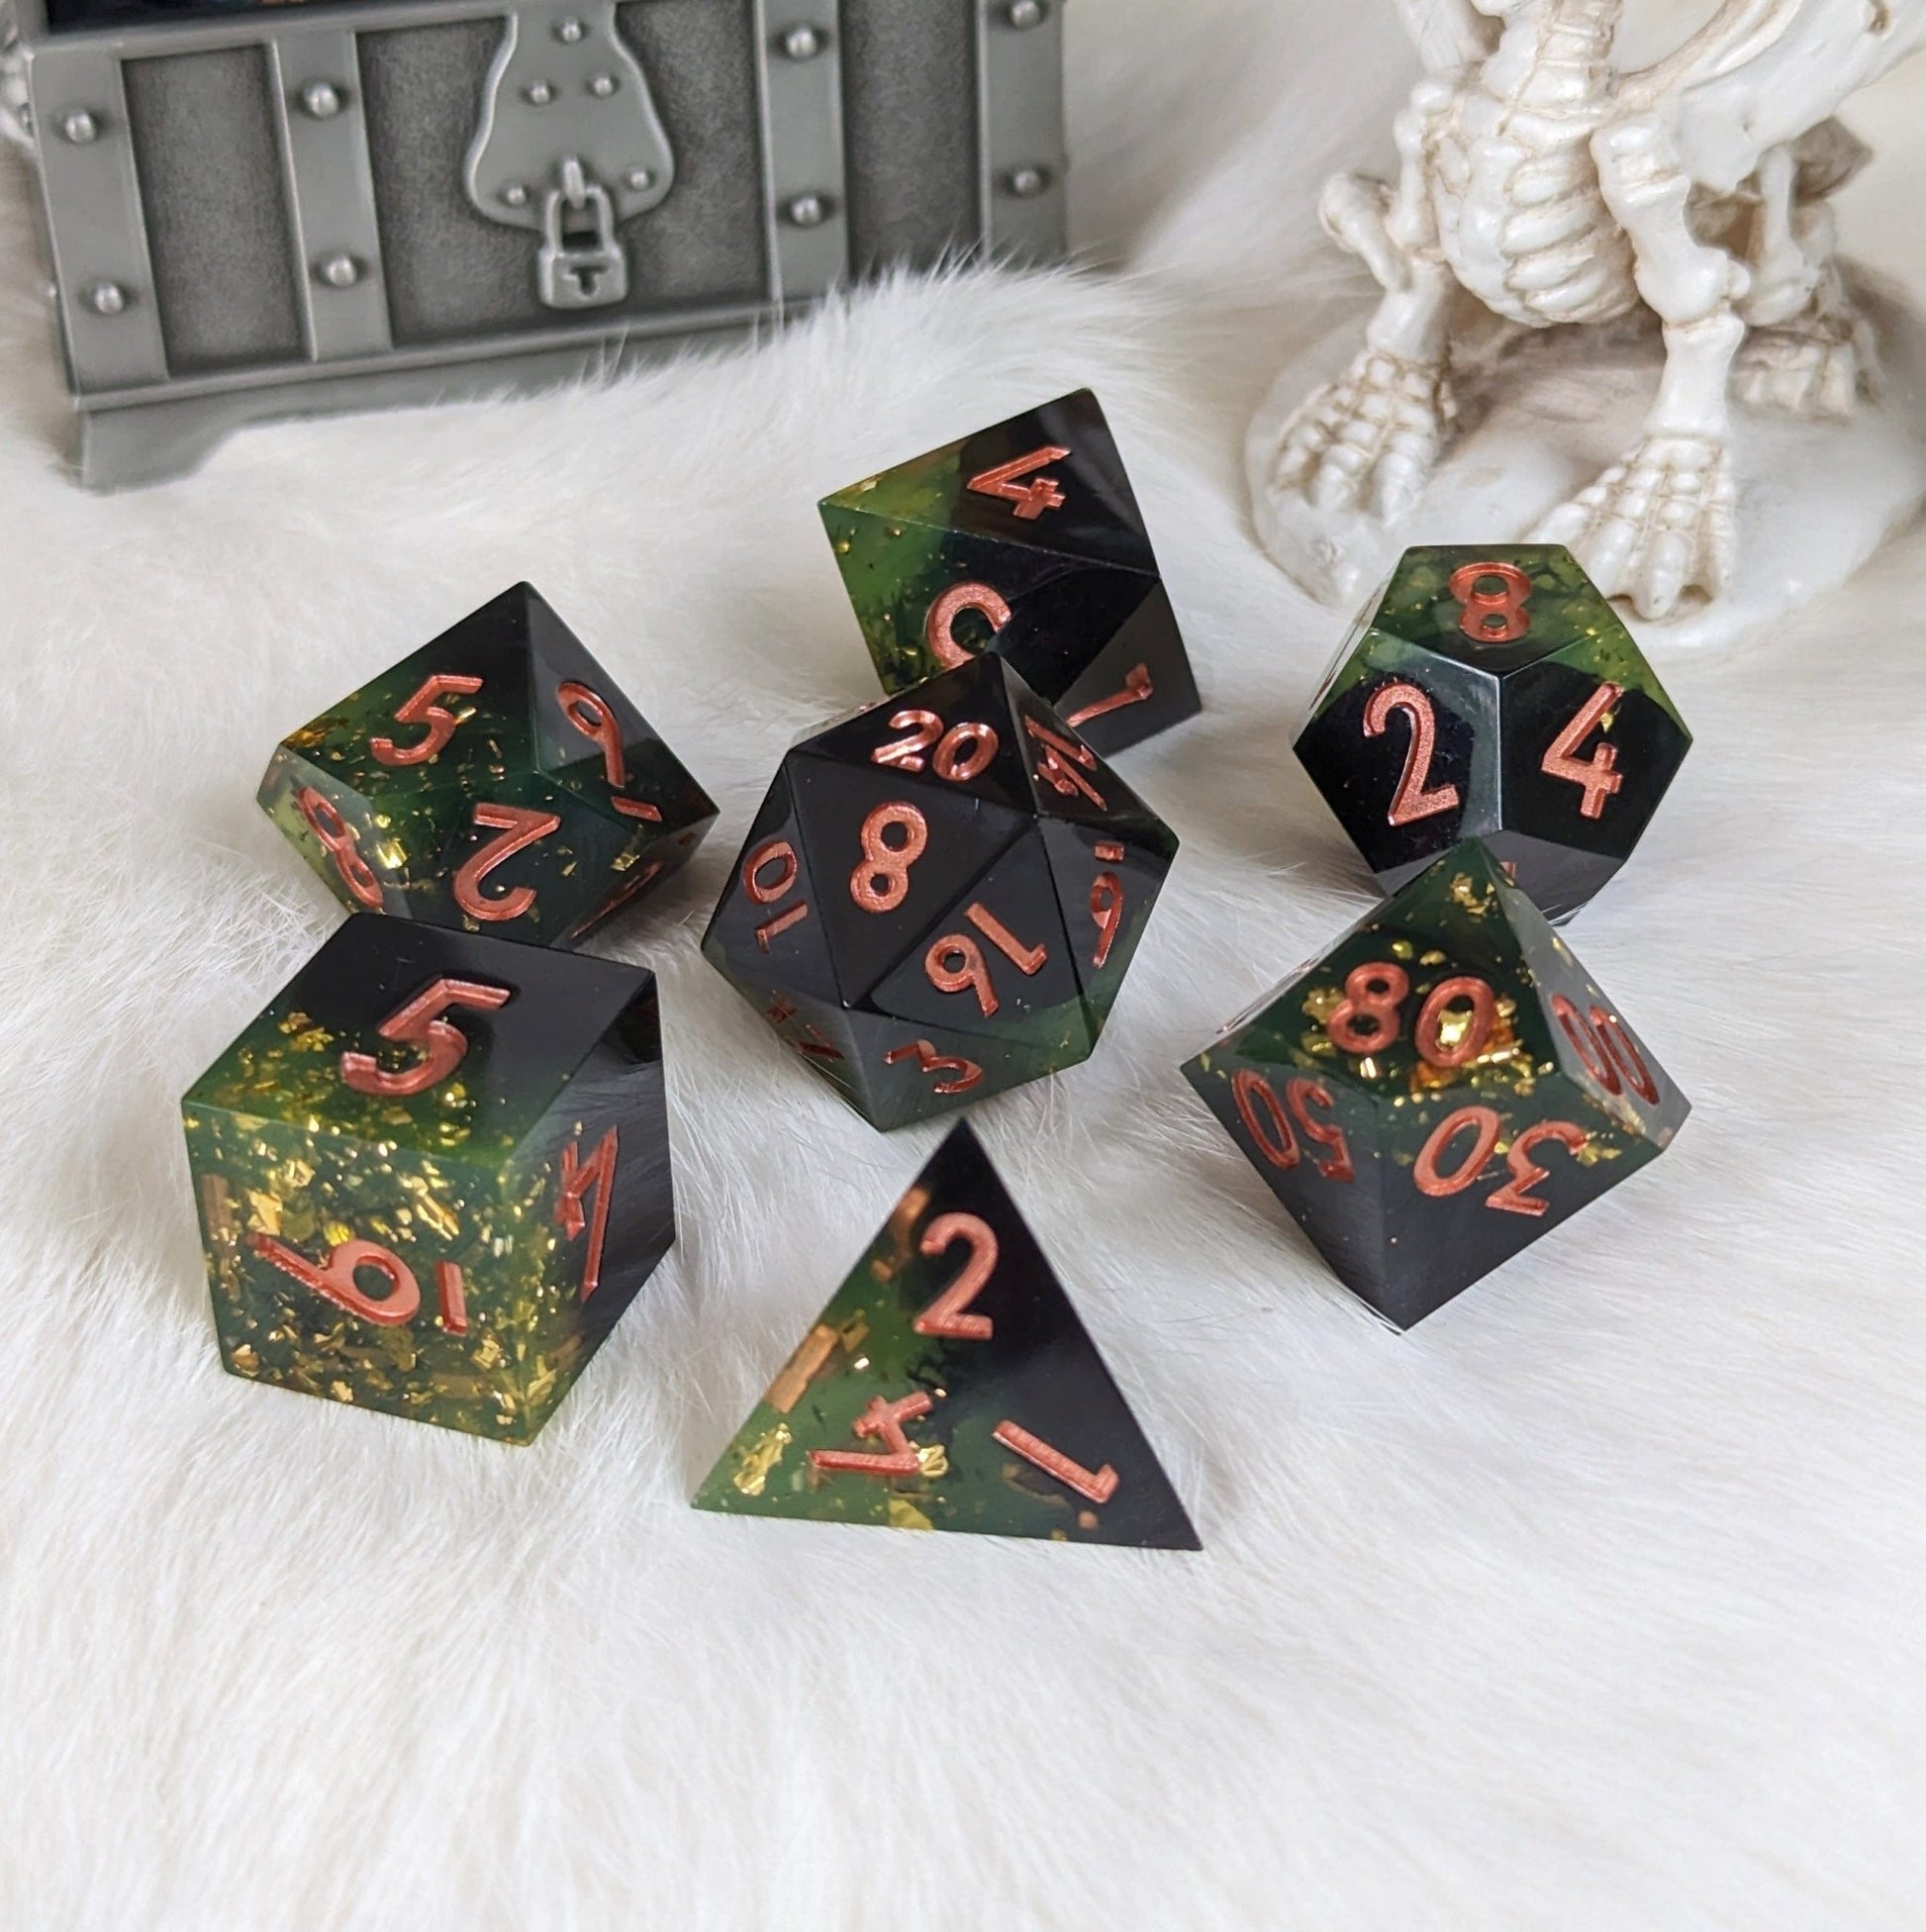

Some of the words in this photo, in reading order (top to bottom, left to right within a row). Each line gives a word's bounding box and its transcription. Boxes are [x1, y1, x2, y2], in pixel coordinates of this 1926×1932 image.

[967, 446, 1072, 521] 4
[1449, 561, 1532, 642] 8
[369, 674, 483, 766] 5
[871, 710, 999, 781] 20
[1024, 715, 1107, 811] 14
[1363, 682, 1460, 826] 2
[1541, 681, 1624, 820] 4
[298, 787, 384, 909] 8
[453, 803, 560, 920] 2
[743, 840, 809, 953] 10
[850, 802, 928, 914] 8
[924, 903, 1047, 1017] 16
[1326, 960, 1495, 1068] 80
[339, 978, 511, 1095] 5
[884, 1039, 984, 1093] 3
[1232, 1068, 1354, 1182] 50
[1413, 1106, 1588, 1216] 30
[553, 1124, 619, 1304] 4
[914, 1212, 998, 1339] 2
[808, 1391, 932, 1477] 4
[992, 1419, 1119, 1504] 1
